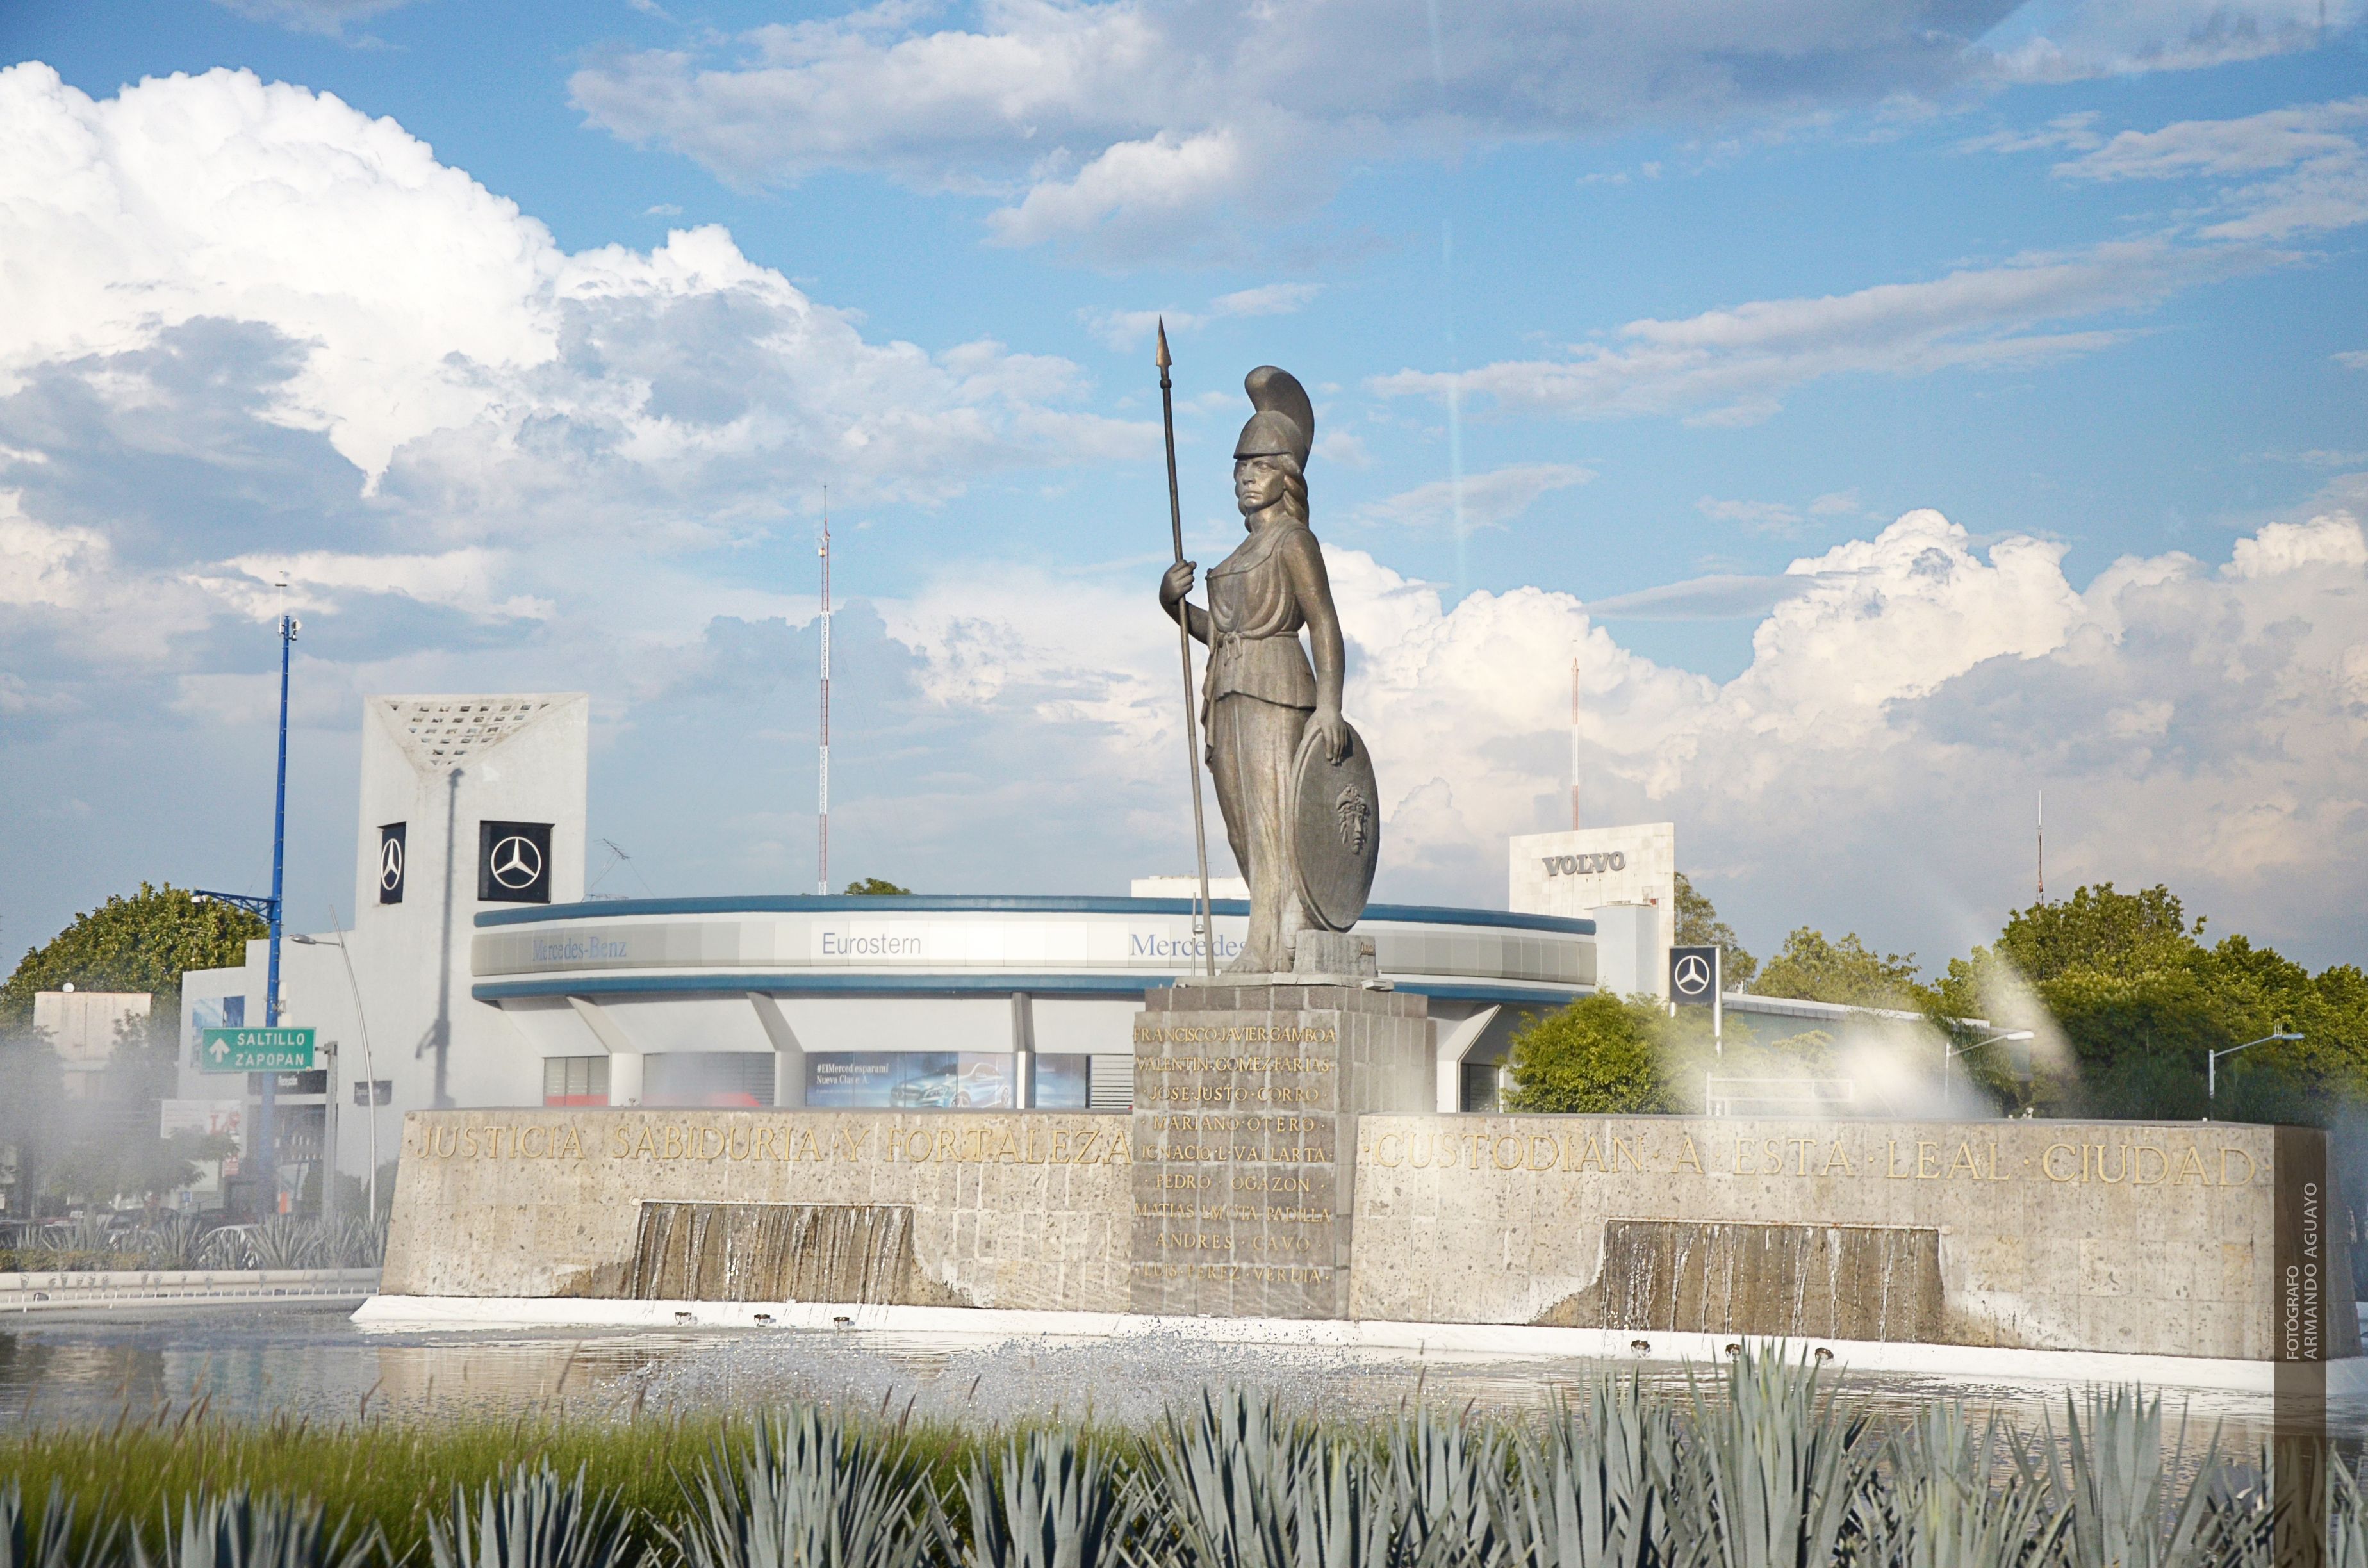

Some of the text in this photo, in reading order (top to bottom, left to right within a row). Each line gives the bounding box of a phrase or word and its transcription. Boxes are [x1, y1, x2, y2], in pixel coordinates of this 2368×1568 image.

[1542, 851, 1626, 876] VOLVO
[532, 936, 627, 961] Mercedes-Benz
[823, 932, 921, 954] Eurostern
[237, 1033, 305, 1046] SALTILLO
[1134, 1027, 1336, 1043] FRANCISCO JAVIER GAMBOA
[235, 1053, 304, 1066] ZAPOPAN
[1135, 1057, 1331, 1072] VALENTIN GOMEZ FARIAS
[816, 1075, 837, 1084] Nueva
[1149, 1087, 1319, 1102] JOSE JUSTO CORRO
[1153, 1116, 1315, 1132] MARIANO OTERO
[415, 1126, 1133, 1164] JUSTICIA SABIDURIA Y FORTALEZA
[1141, 1145, 1211, 1159] IGNACIO
[1235, 1147, 1327, 1162] VALLARTA
[1374, 1132, 2257, 1186] CUSTODIAN A ESTA LEAL CIUDAD
[1156, 1174, 1310, 1192] PEDRO OGAZON
[1135, 1203, 1194, 1218] MATIAS
[1267, 1206, 1332, 1223] PADILLA
[1155, 1232, 1310, 1252] ANDRES CAVO
[1144, 1262, 1321, 1283] LUIS PEREZ VERDIA
